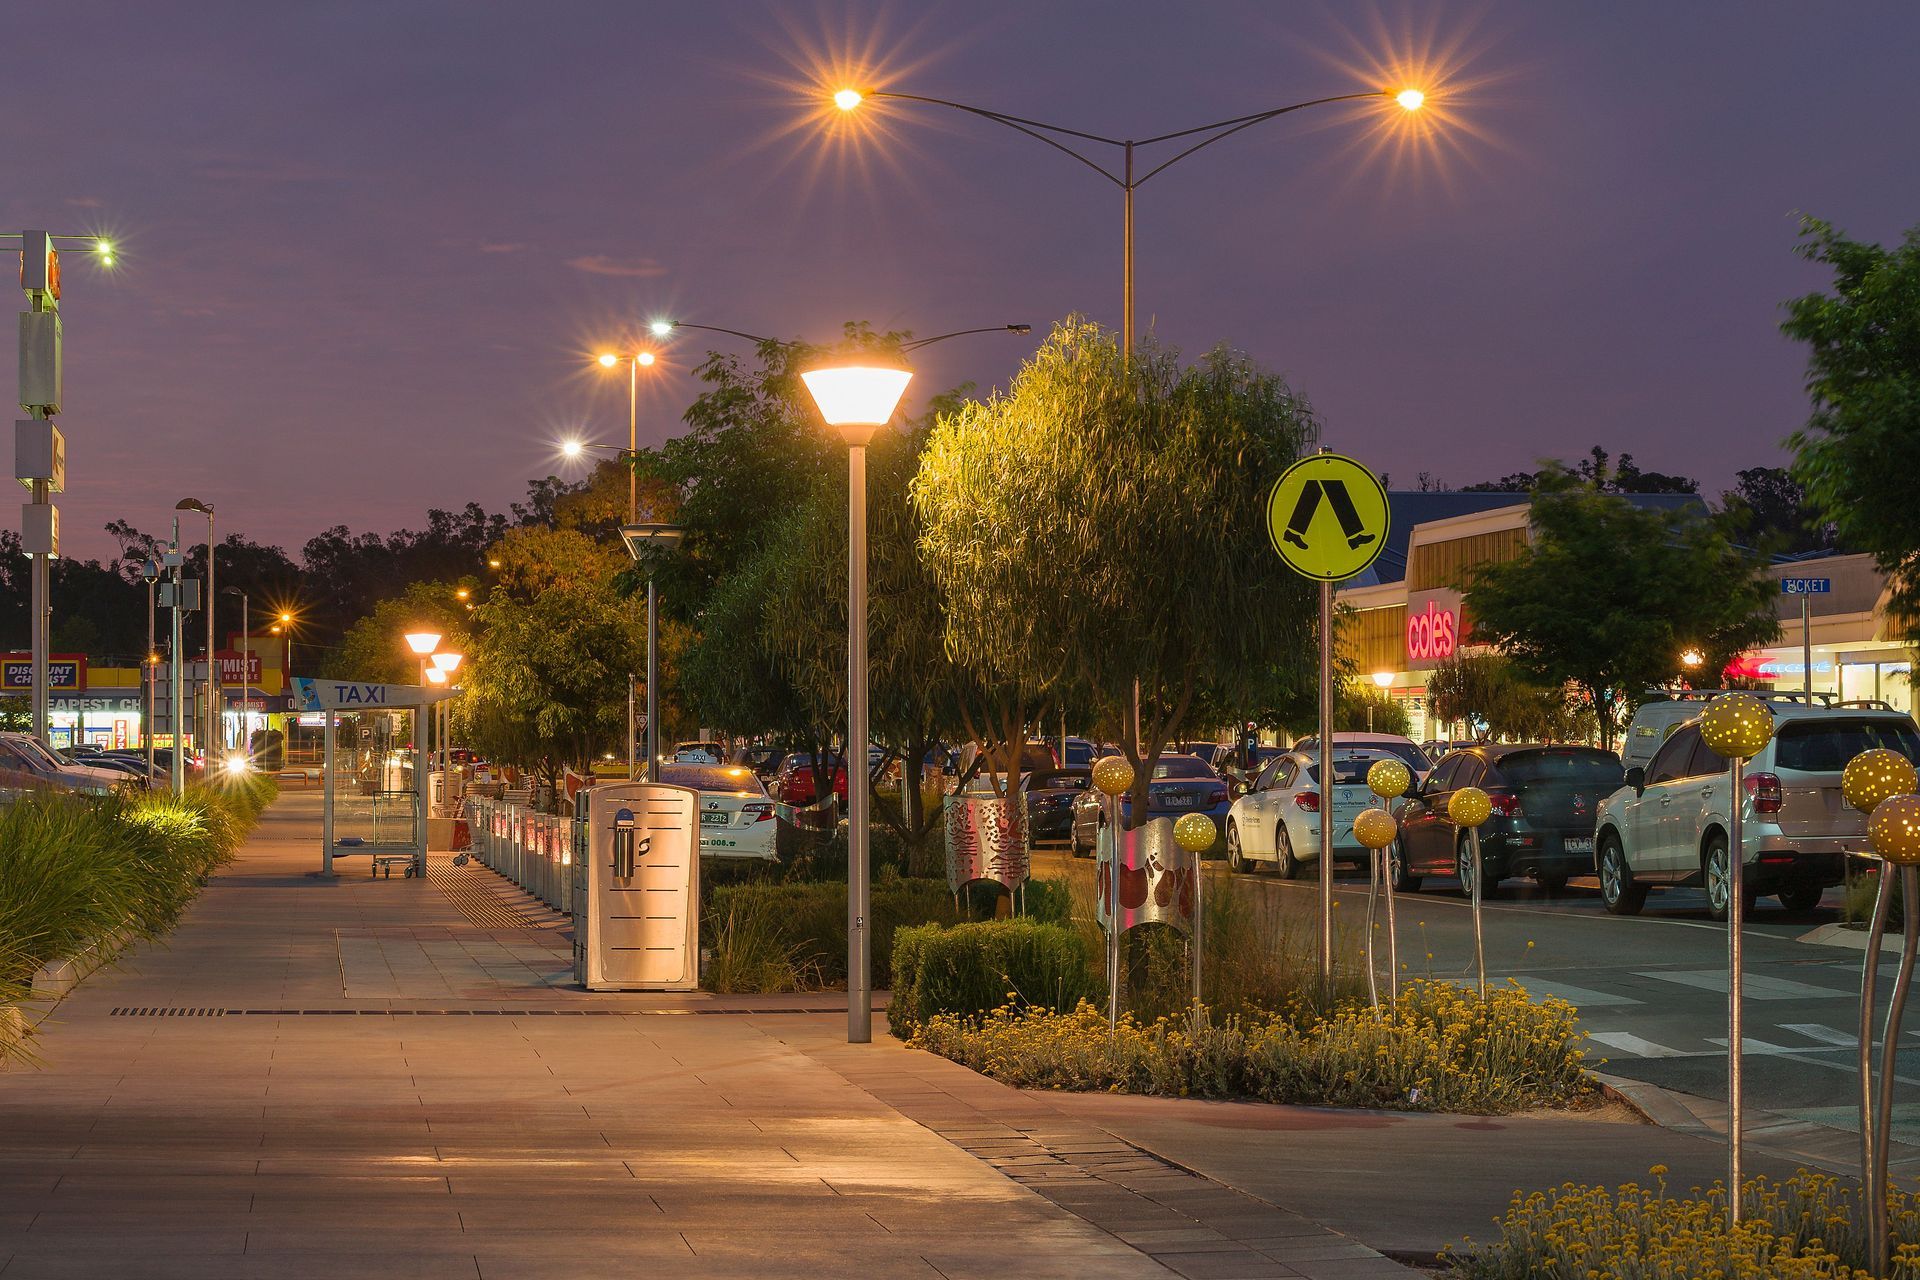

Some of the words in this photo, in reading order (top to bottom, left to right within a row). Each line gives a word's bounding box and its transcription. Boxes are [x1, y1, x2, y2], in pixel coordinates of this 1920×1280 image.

[1408, 601, 1453, 659] coles
[8, 666, 73, 675] DISCUNT
[223, 659, 258, 672] MIST
[14, 675, 68, 684] CHIST
[334, 685, 386, 703] TAXI
[361, 729, 370, 739] P
[1247, 738, 1255, 750] P
[710, 814, 727, 822] 2212
